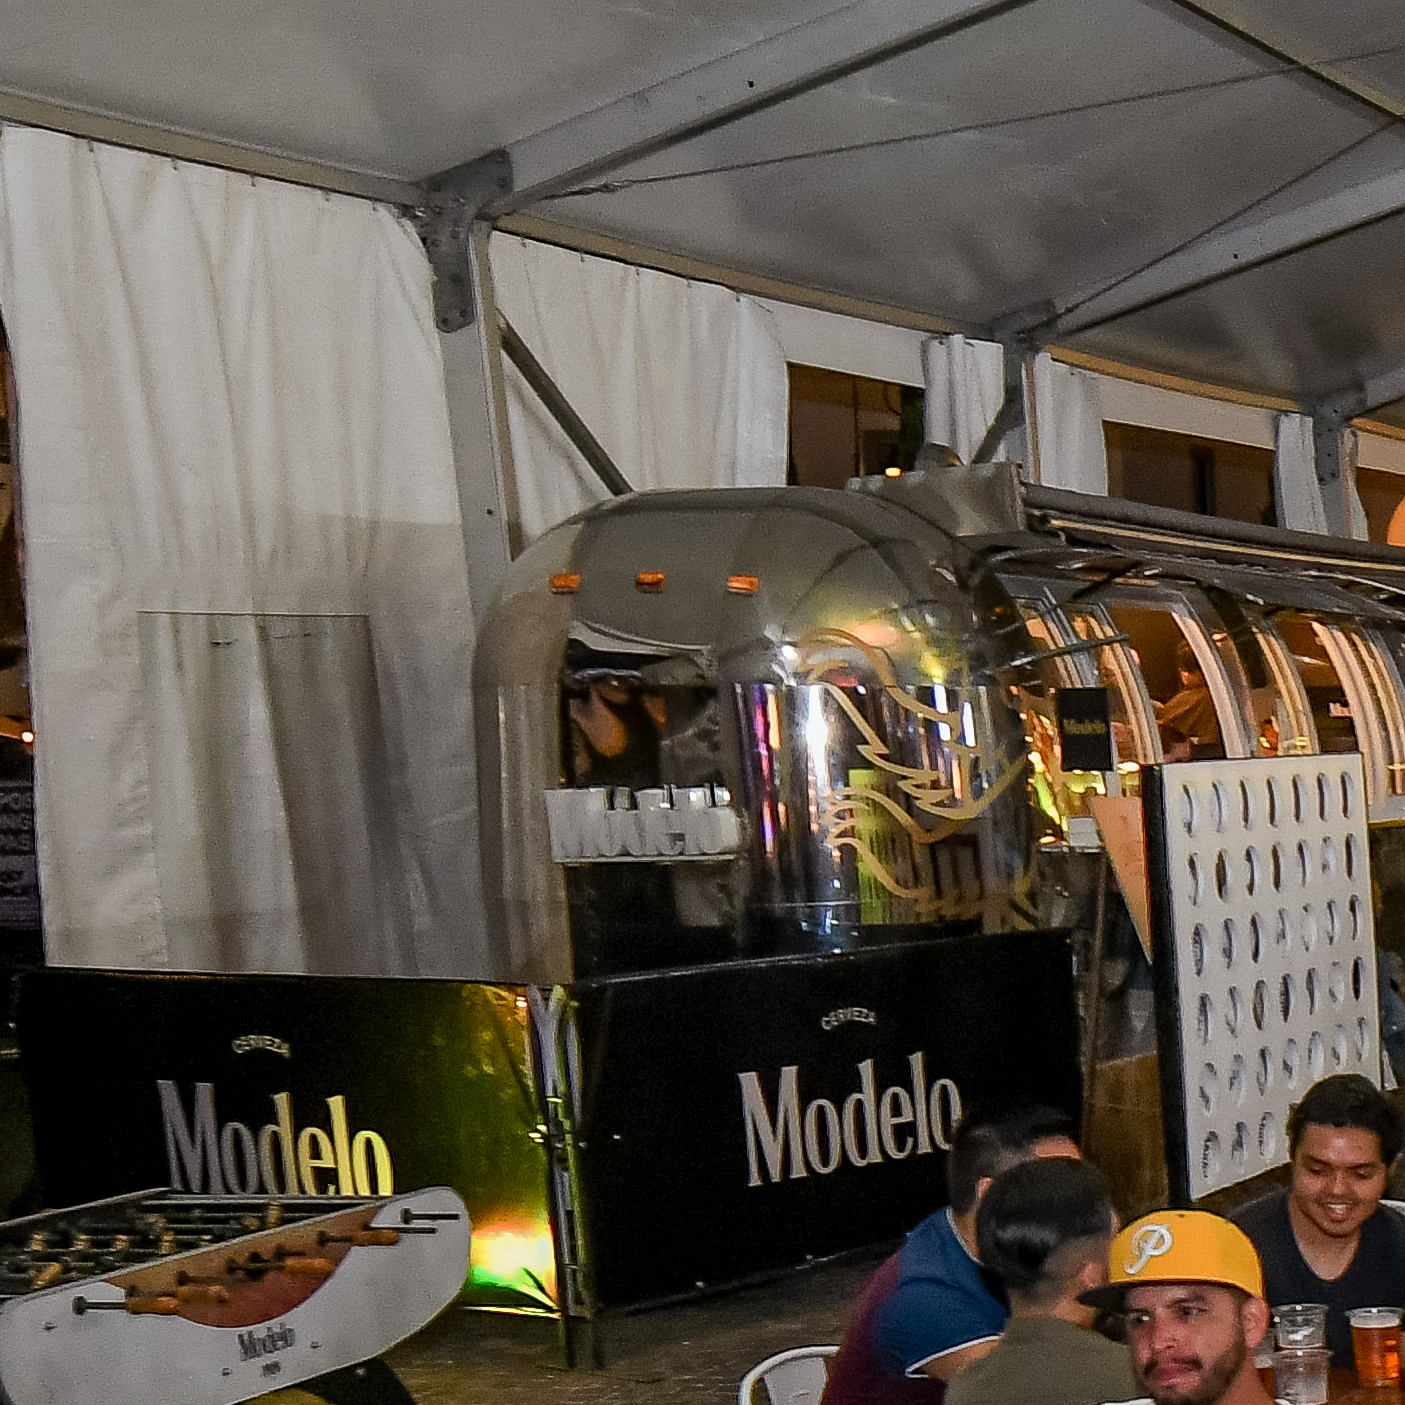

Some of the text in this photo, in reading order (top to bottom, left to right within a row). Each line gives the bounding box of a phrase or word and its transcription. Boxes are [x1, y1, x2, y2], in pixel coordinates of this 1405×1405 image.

[157, 1079, 394, 1196] Modelo
[737, 1051, 963, 1187] Modelo
[1123, 1223, 1174, 1275] P
